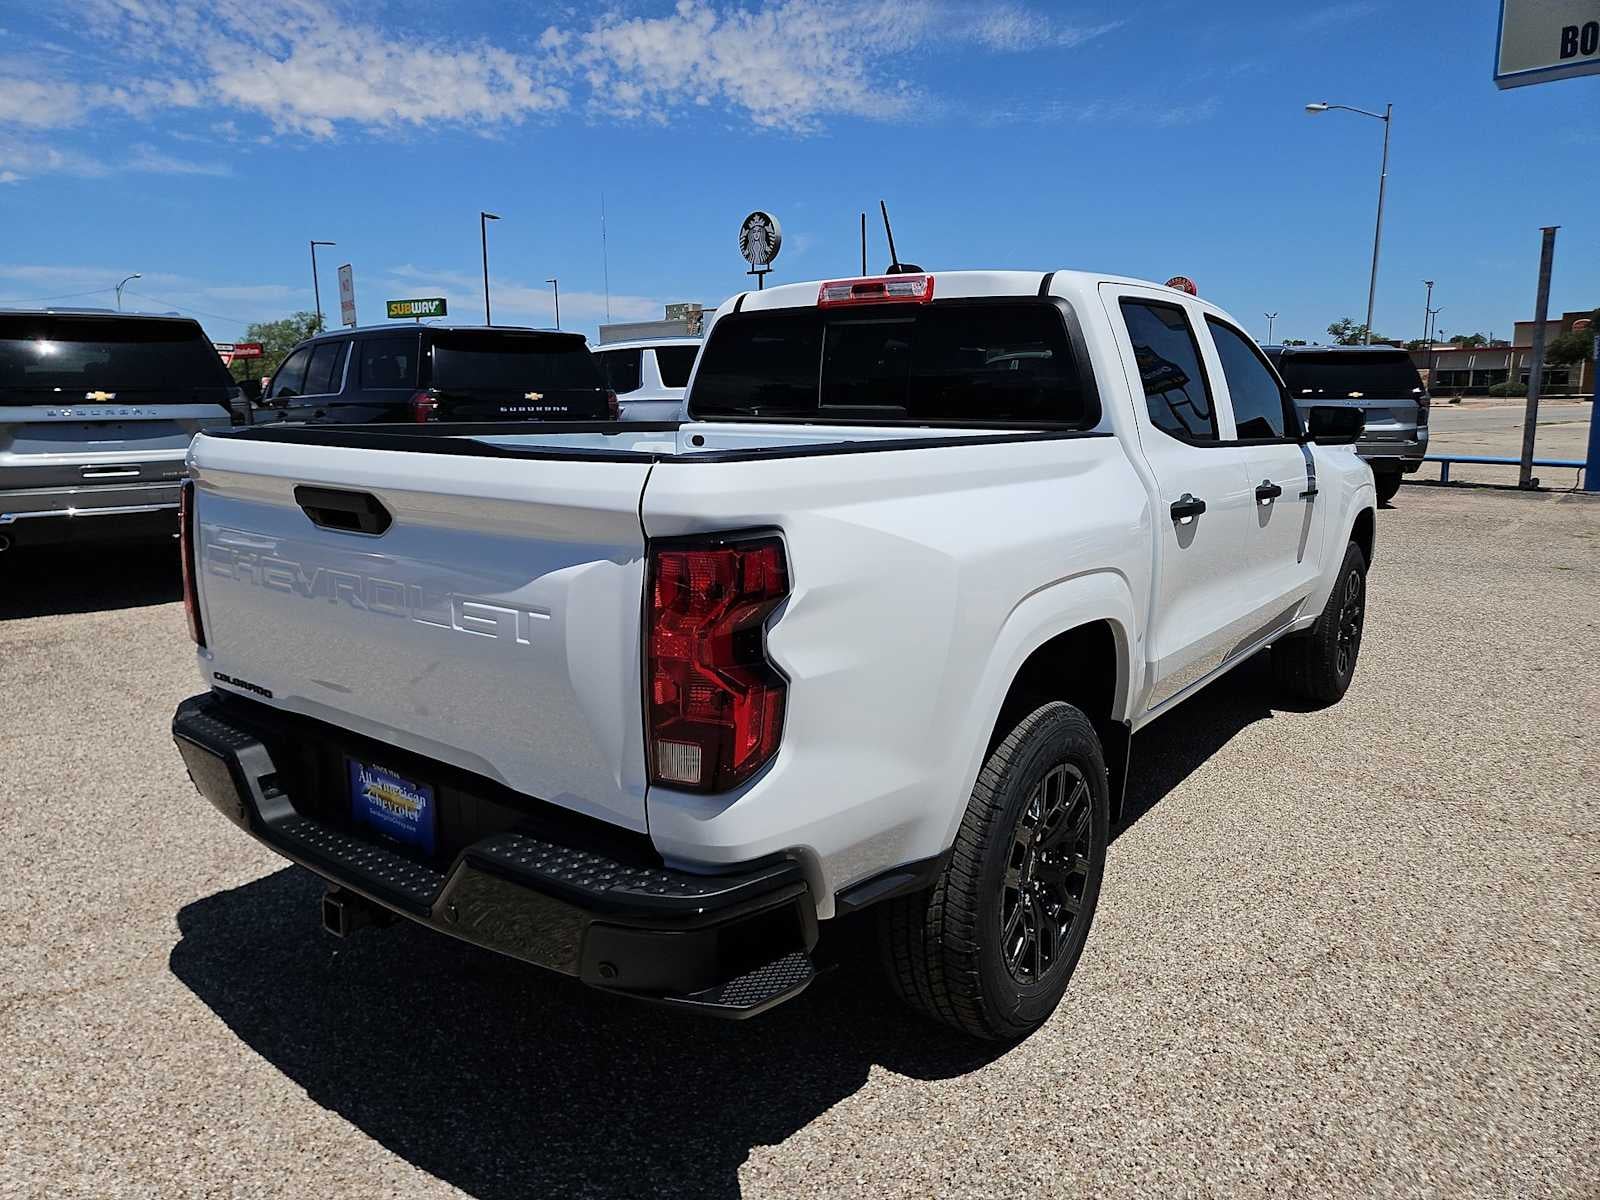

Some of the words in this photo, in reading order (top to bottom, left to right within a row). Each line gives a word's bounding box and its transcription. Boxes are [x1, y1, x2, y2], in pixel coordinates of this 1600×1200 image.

[1560, 21, 1600, 59] BO
[390, 301, 438, 314] SUBWAY
[202, 537, 551, 645] CHEVROLET
[213, 671, 273, 699] COLORADO
[367, 790, 421, 822] Chevrolet
[377, 778, 427, 807] American
